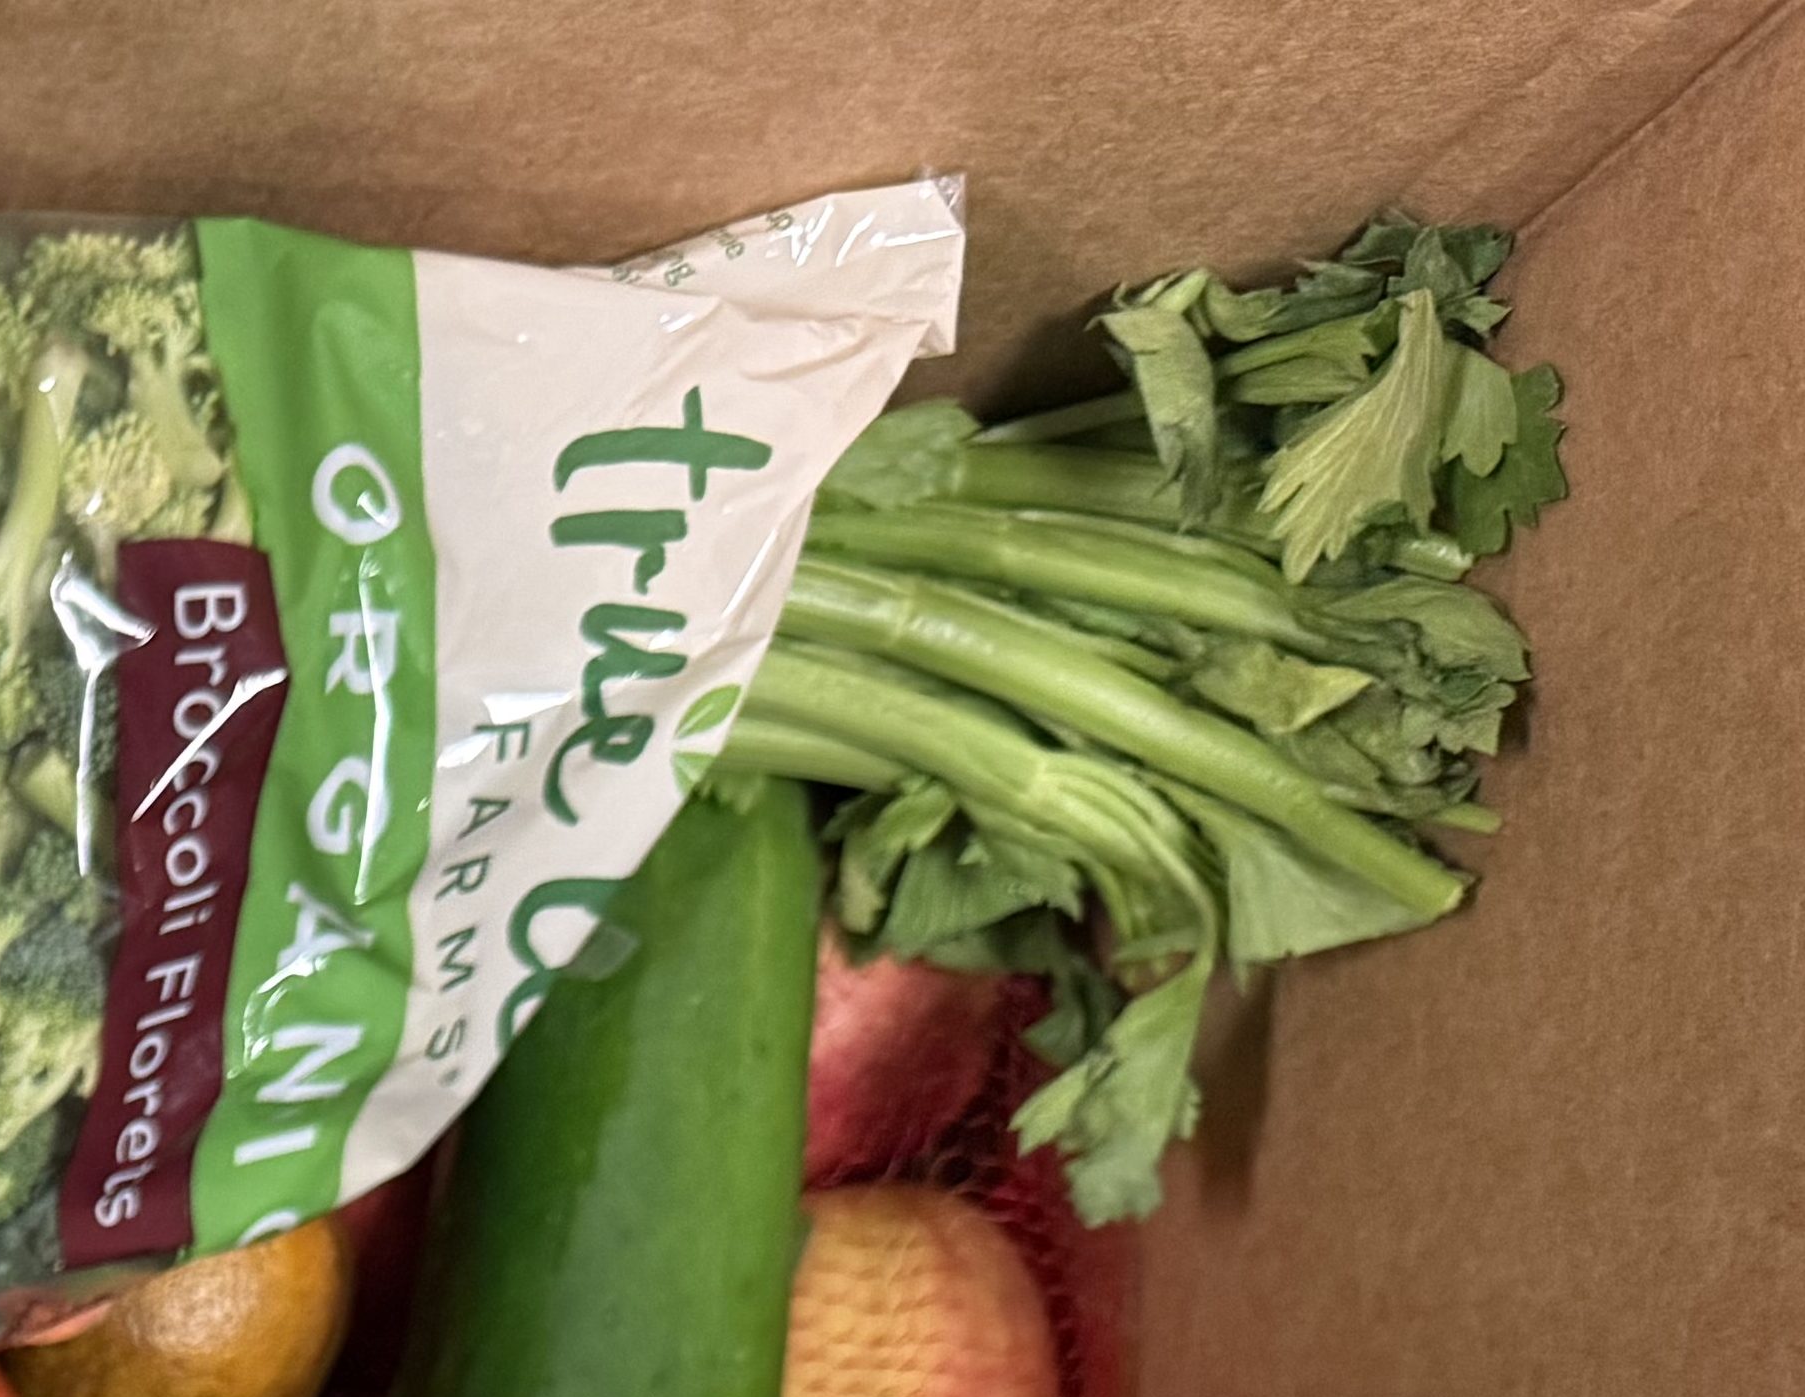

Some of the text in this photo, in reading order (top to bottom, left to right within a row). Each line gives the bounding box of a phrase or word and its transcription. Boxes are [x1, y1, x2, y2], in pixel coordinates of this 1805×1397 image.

[544, 386, 773, 826] true
[93, 580, 248, 1227] Broccoli Florets
